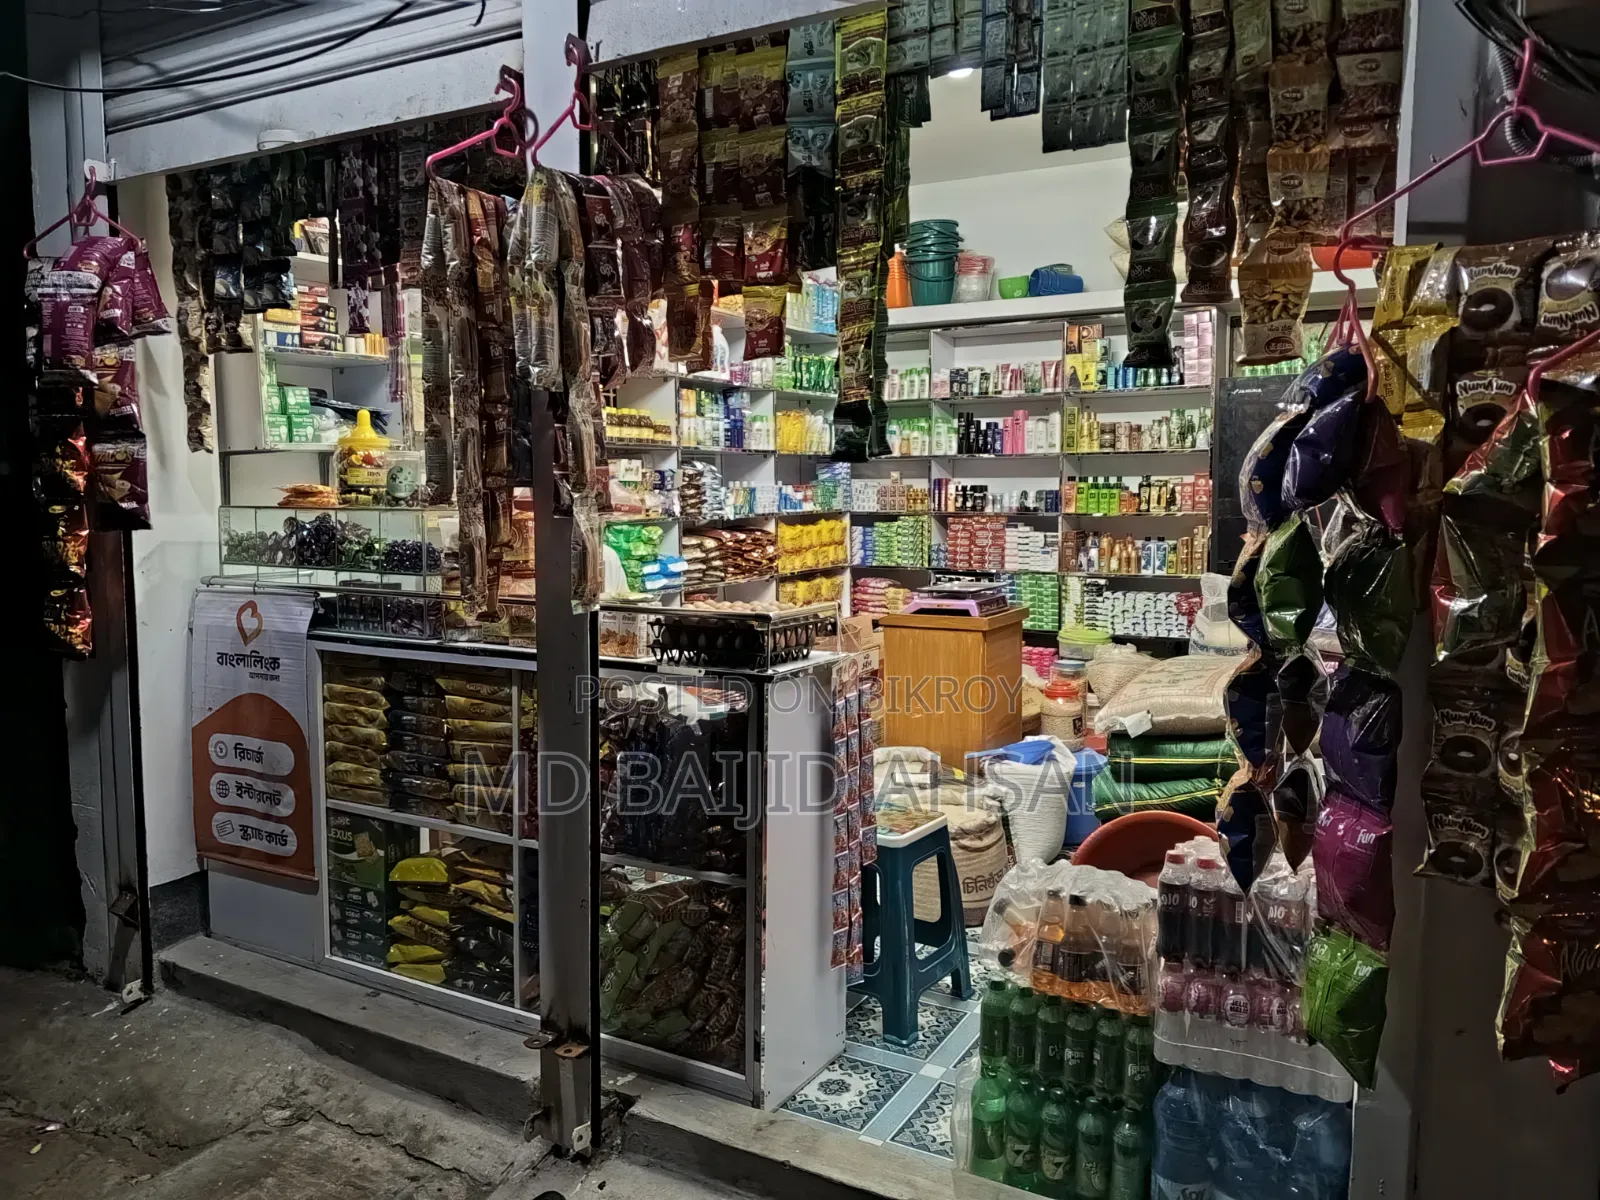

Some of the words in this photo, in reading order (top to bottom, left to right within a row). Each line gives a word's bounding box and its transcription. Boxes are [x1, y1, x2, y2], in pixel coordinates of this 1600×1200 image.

[216, 649, 281, 672] বাংলালিংক
[233, 742, 265, 765] রিচার্জ
[234, 780, 282, 806] ইন্টারনেট
[264, 829, 288, 847] কার্ড
